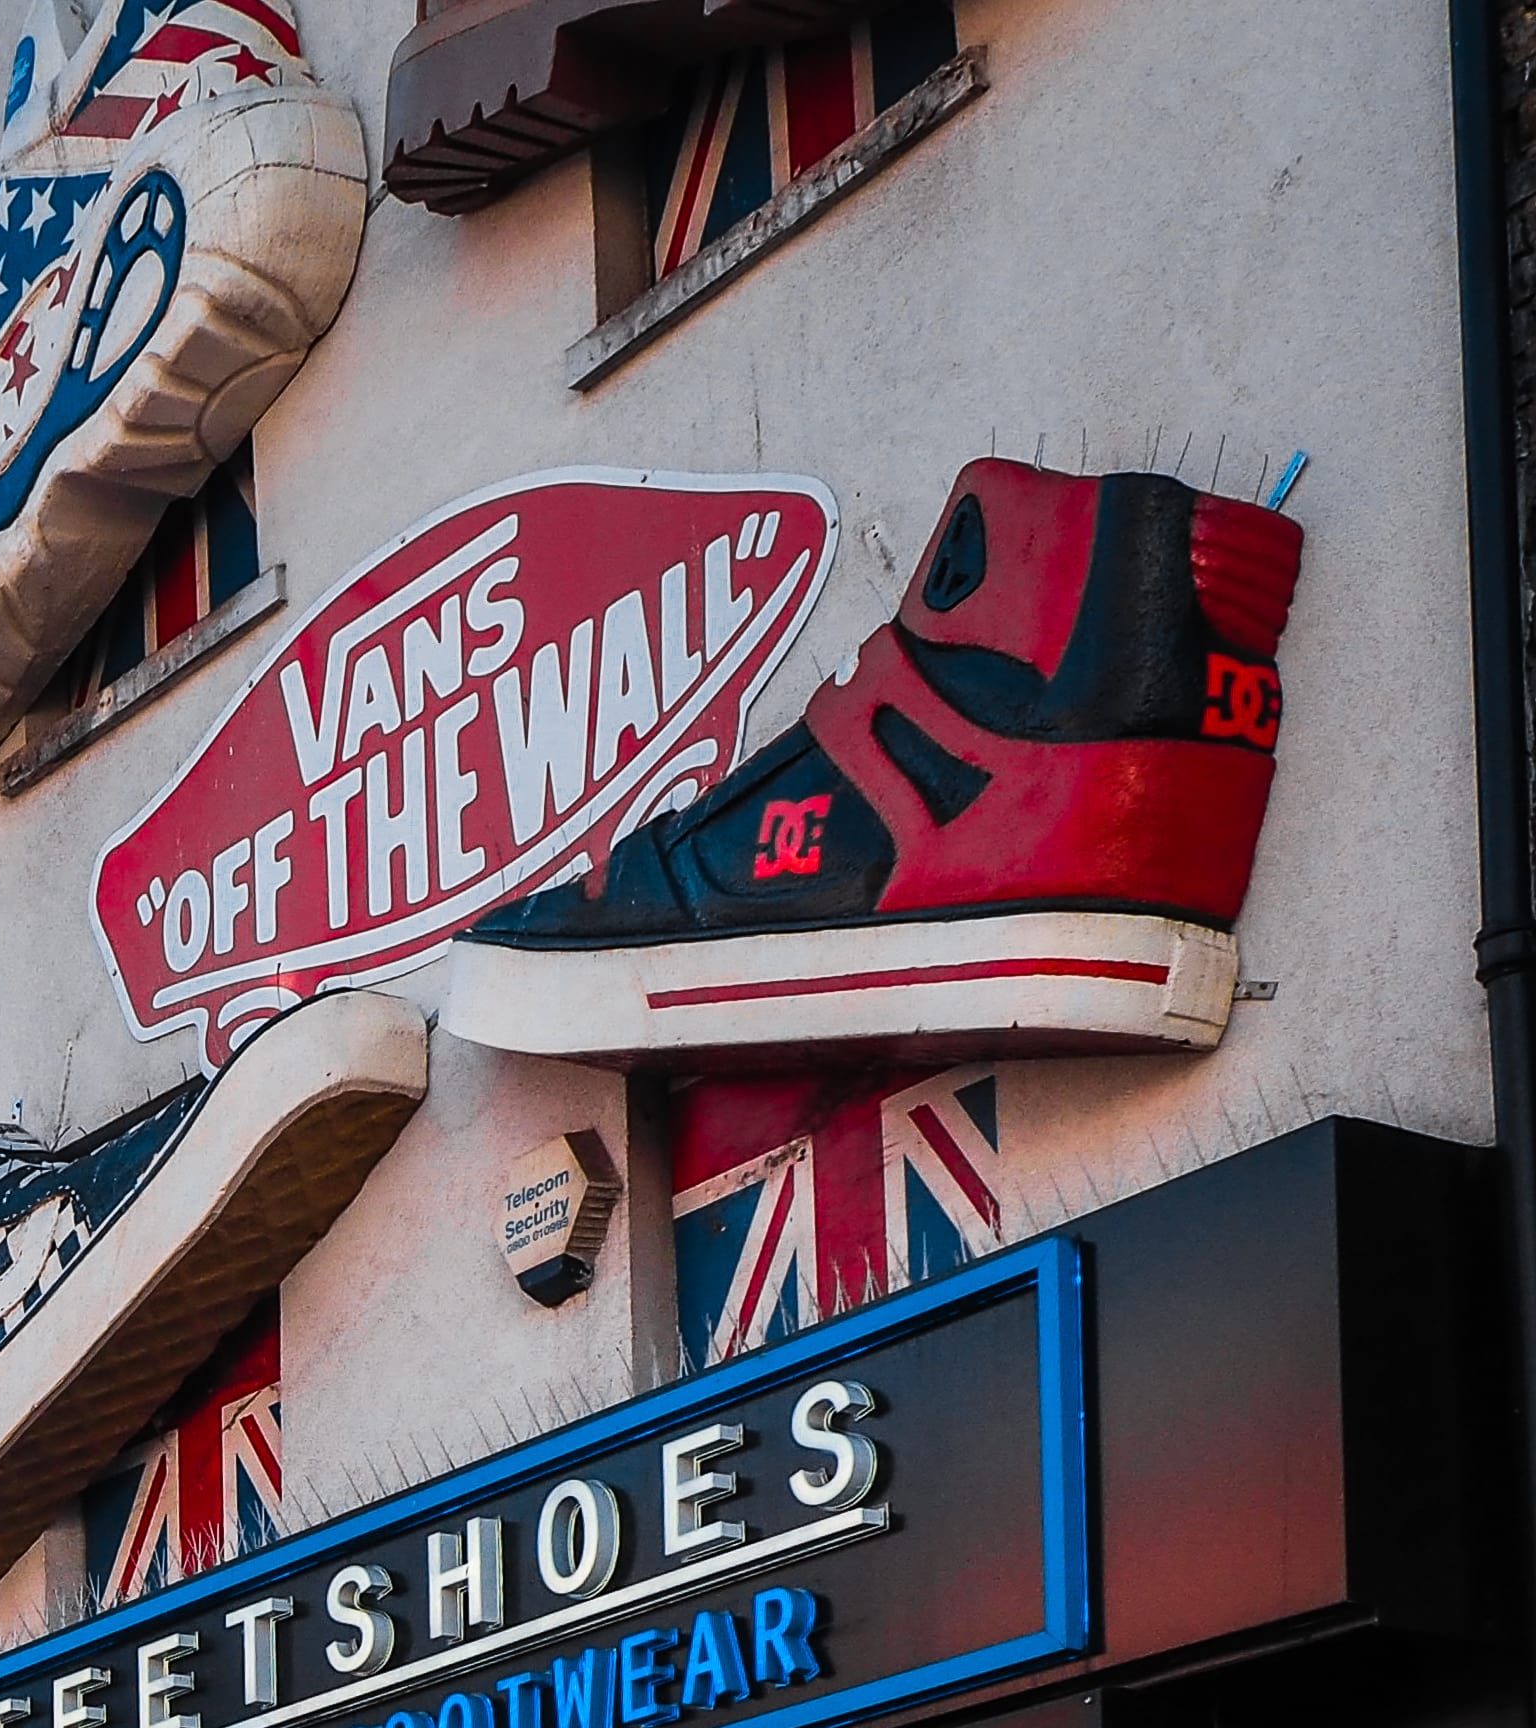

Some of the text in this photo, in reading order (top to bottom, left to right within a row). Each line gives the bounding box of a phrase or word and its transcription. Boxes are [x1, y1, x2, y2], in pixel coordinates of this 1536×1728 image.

[279, 512, 525, 786] VANS
[308, 692, 487, 931] THE
[504, 1170, 570, 1212] Telecom
[505, 1196, 570, 1241] Security
[506, 1235, 531, 1254] 0800
